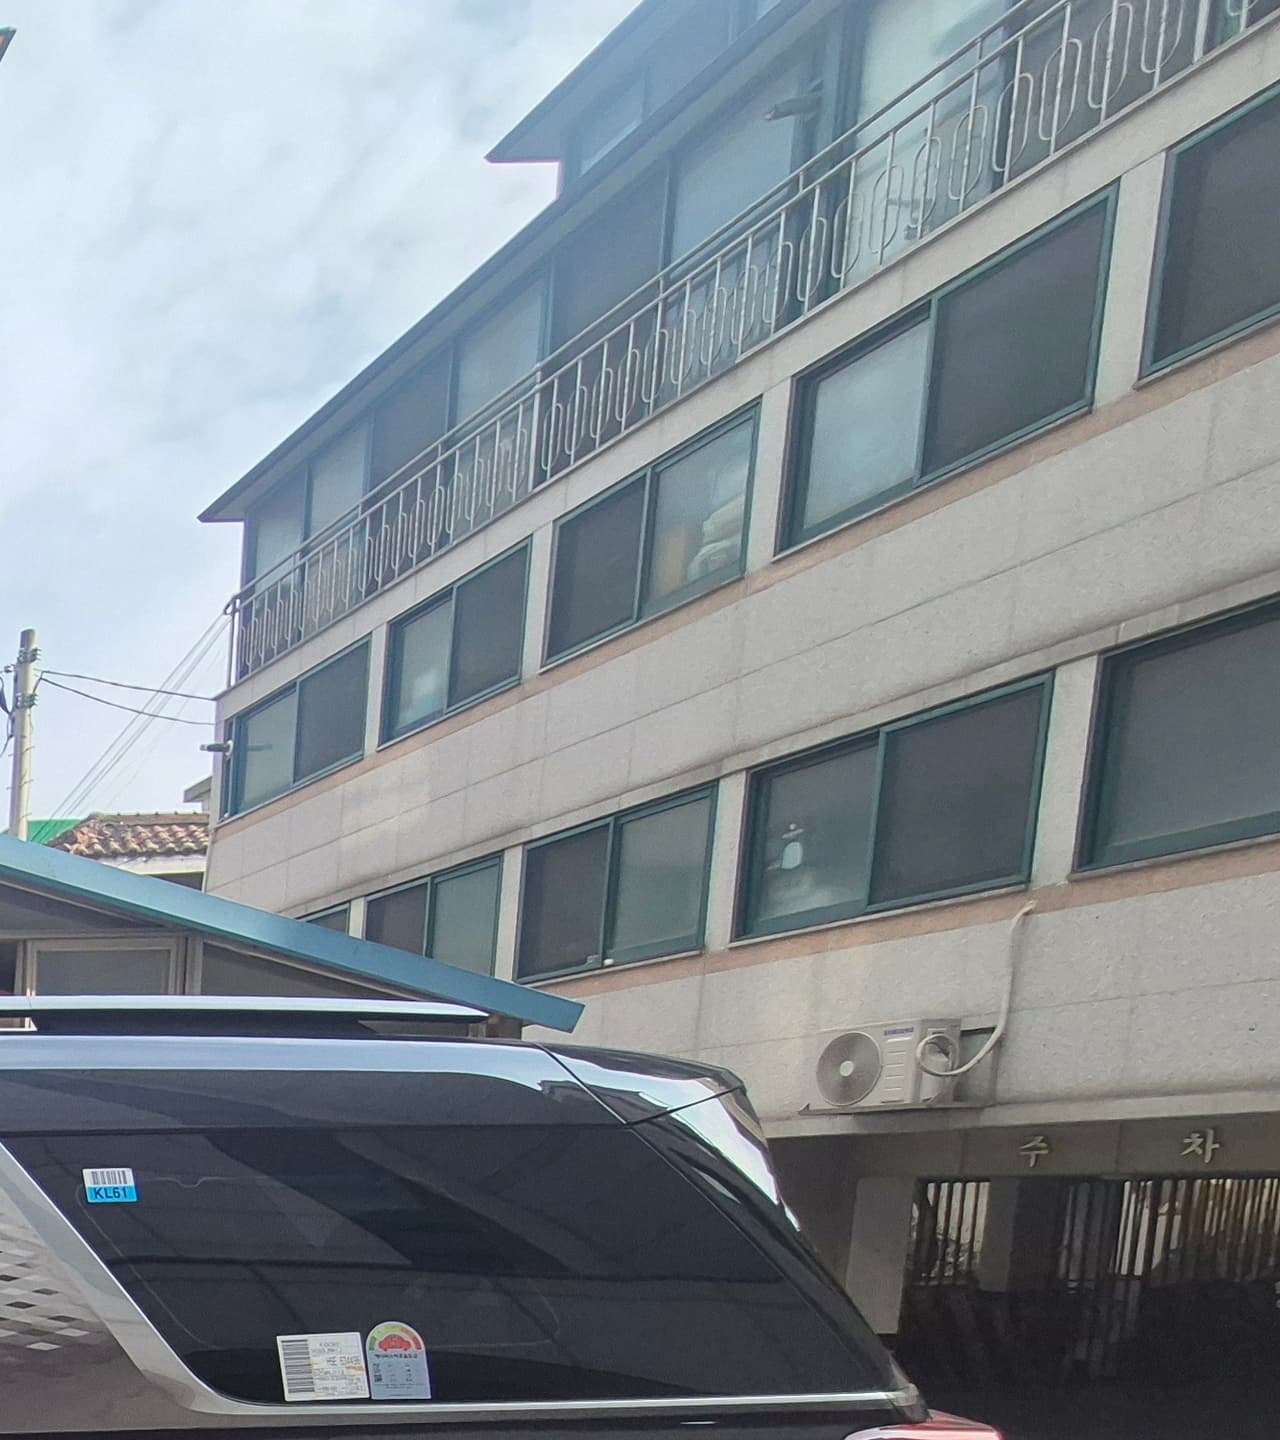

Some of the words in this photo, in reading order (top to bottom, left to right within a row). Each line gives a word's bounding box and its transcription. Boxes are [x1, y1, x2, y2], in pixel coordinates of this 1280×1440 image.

[1019, 1135, 1049, 1167] 주
[1180, 1128, 1220, 1164] 차
[94, 1186, 127, 1199] KL61
